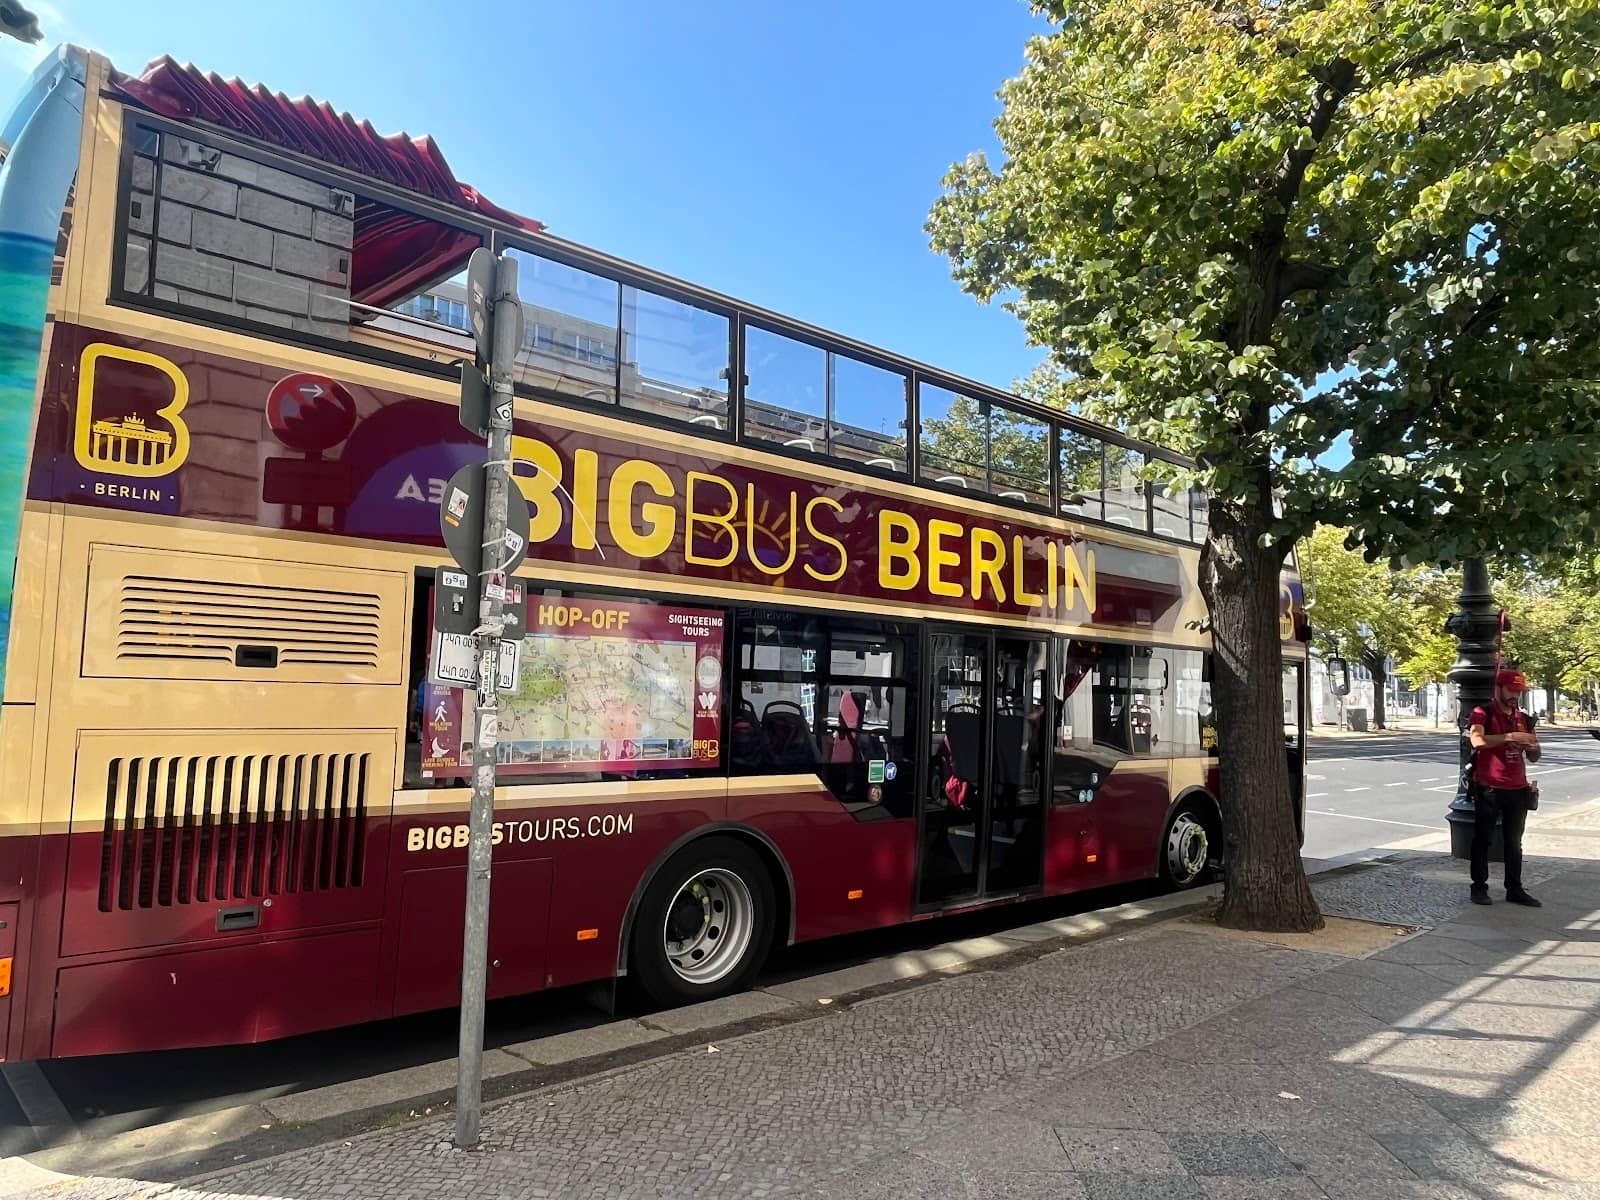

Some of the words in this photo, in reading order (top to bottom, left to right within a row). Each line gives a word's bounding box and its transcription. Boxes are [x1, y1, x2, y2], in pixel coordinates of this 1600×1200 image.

[95, 482, 161, 501] BERLIN
[878, 509, 1097, 614] BERLIN
[538, 605, 630, 630] HOP-OFF
[668, 614, 723, 627] SIGHTSEEING
[446, 633, 461, 646] Uhr
[682, 626, 710, 637] TOURS
[441, 665, 457, 677] Uhr
[407, 813, 634, 851] BIGBSTOURS.COM
